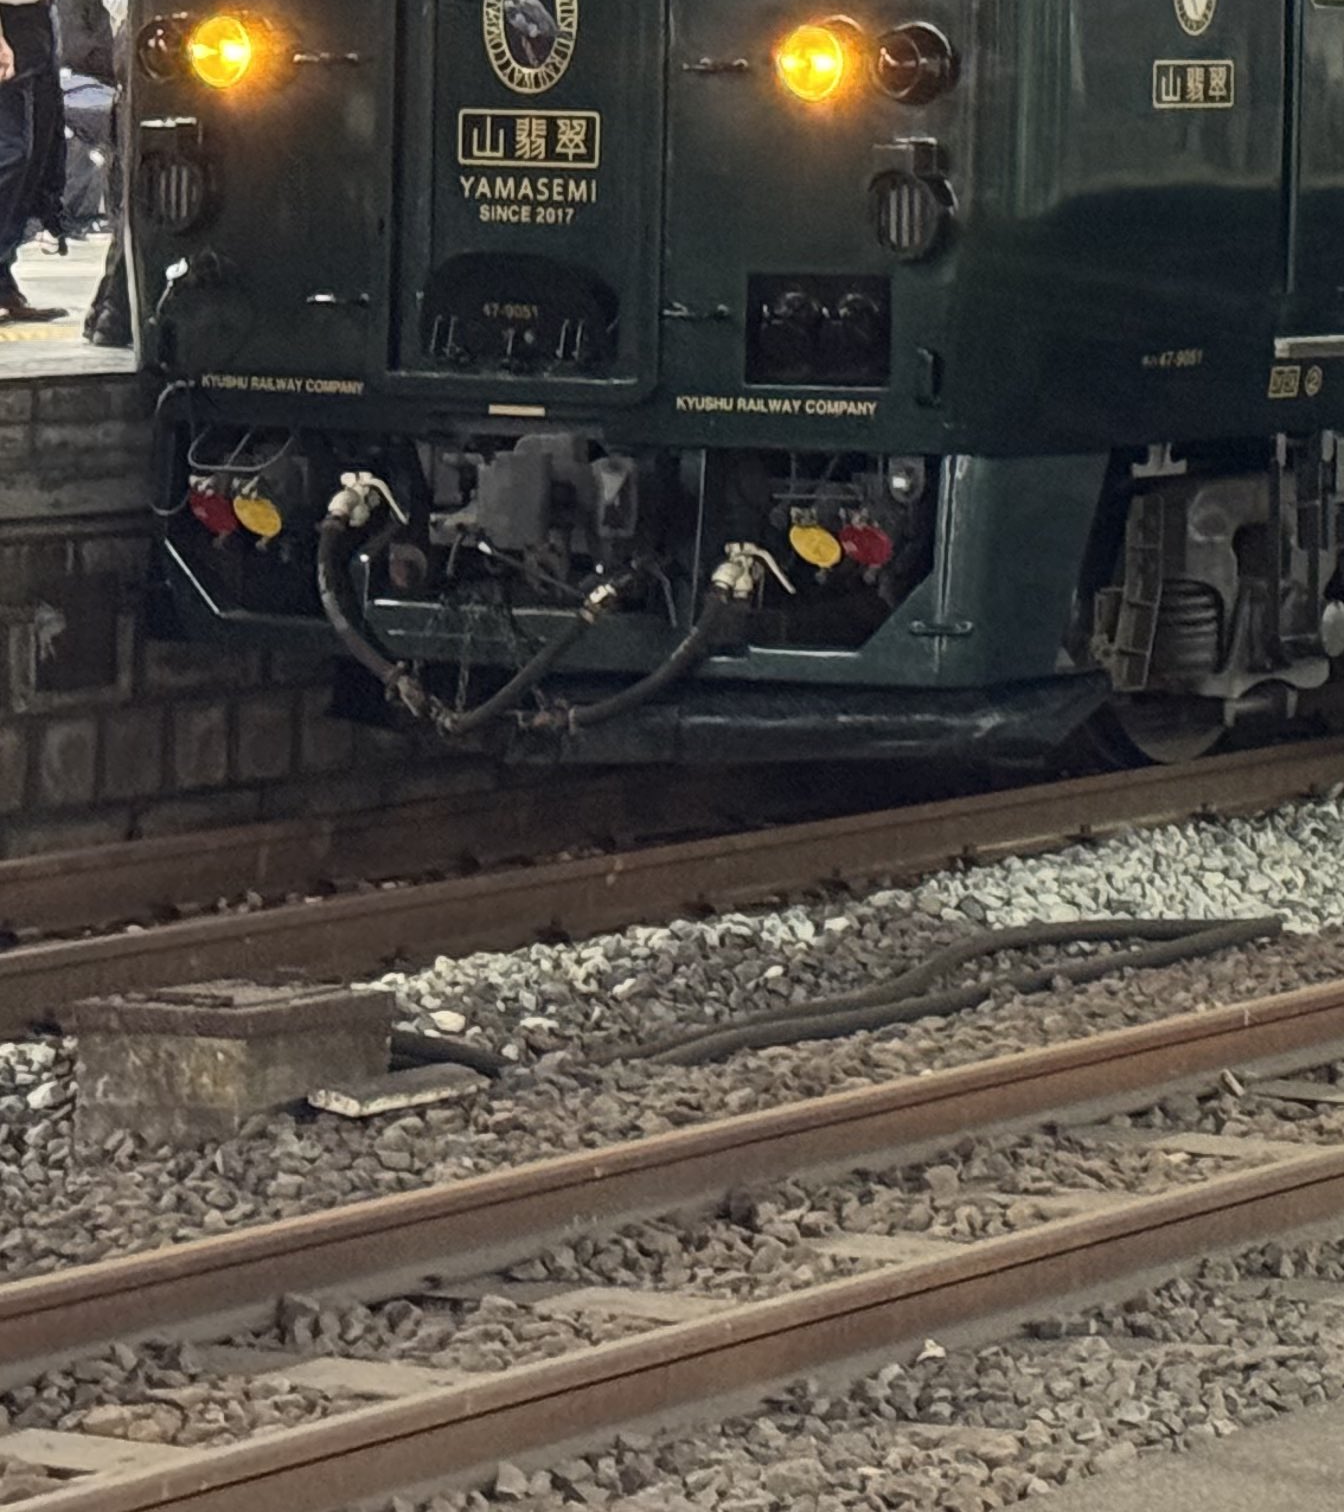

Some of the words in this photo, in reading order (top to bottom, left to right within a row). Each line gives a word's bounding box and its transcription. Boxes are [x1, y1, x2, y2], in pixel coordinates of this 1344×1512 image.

[472, 116, 587, 161] 山翡翠
[460, 175, 597, 203] YAMASEMI
[479, 204, 532, 223] SINCE
[535, 207, 575, 224] 2017
[202, 373, 248, 389] KYUSHU
[251, 376, 302, 392] RAILWAY
[306, 379, 365, 394] COMPANY
[676, 396, 734, 411] KYUSHU
[737, 397, 801, 413] RAILWAY
[805, 399, 877, 416] COMPANY
